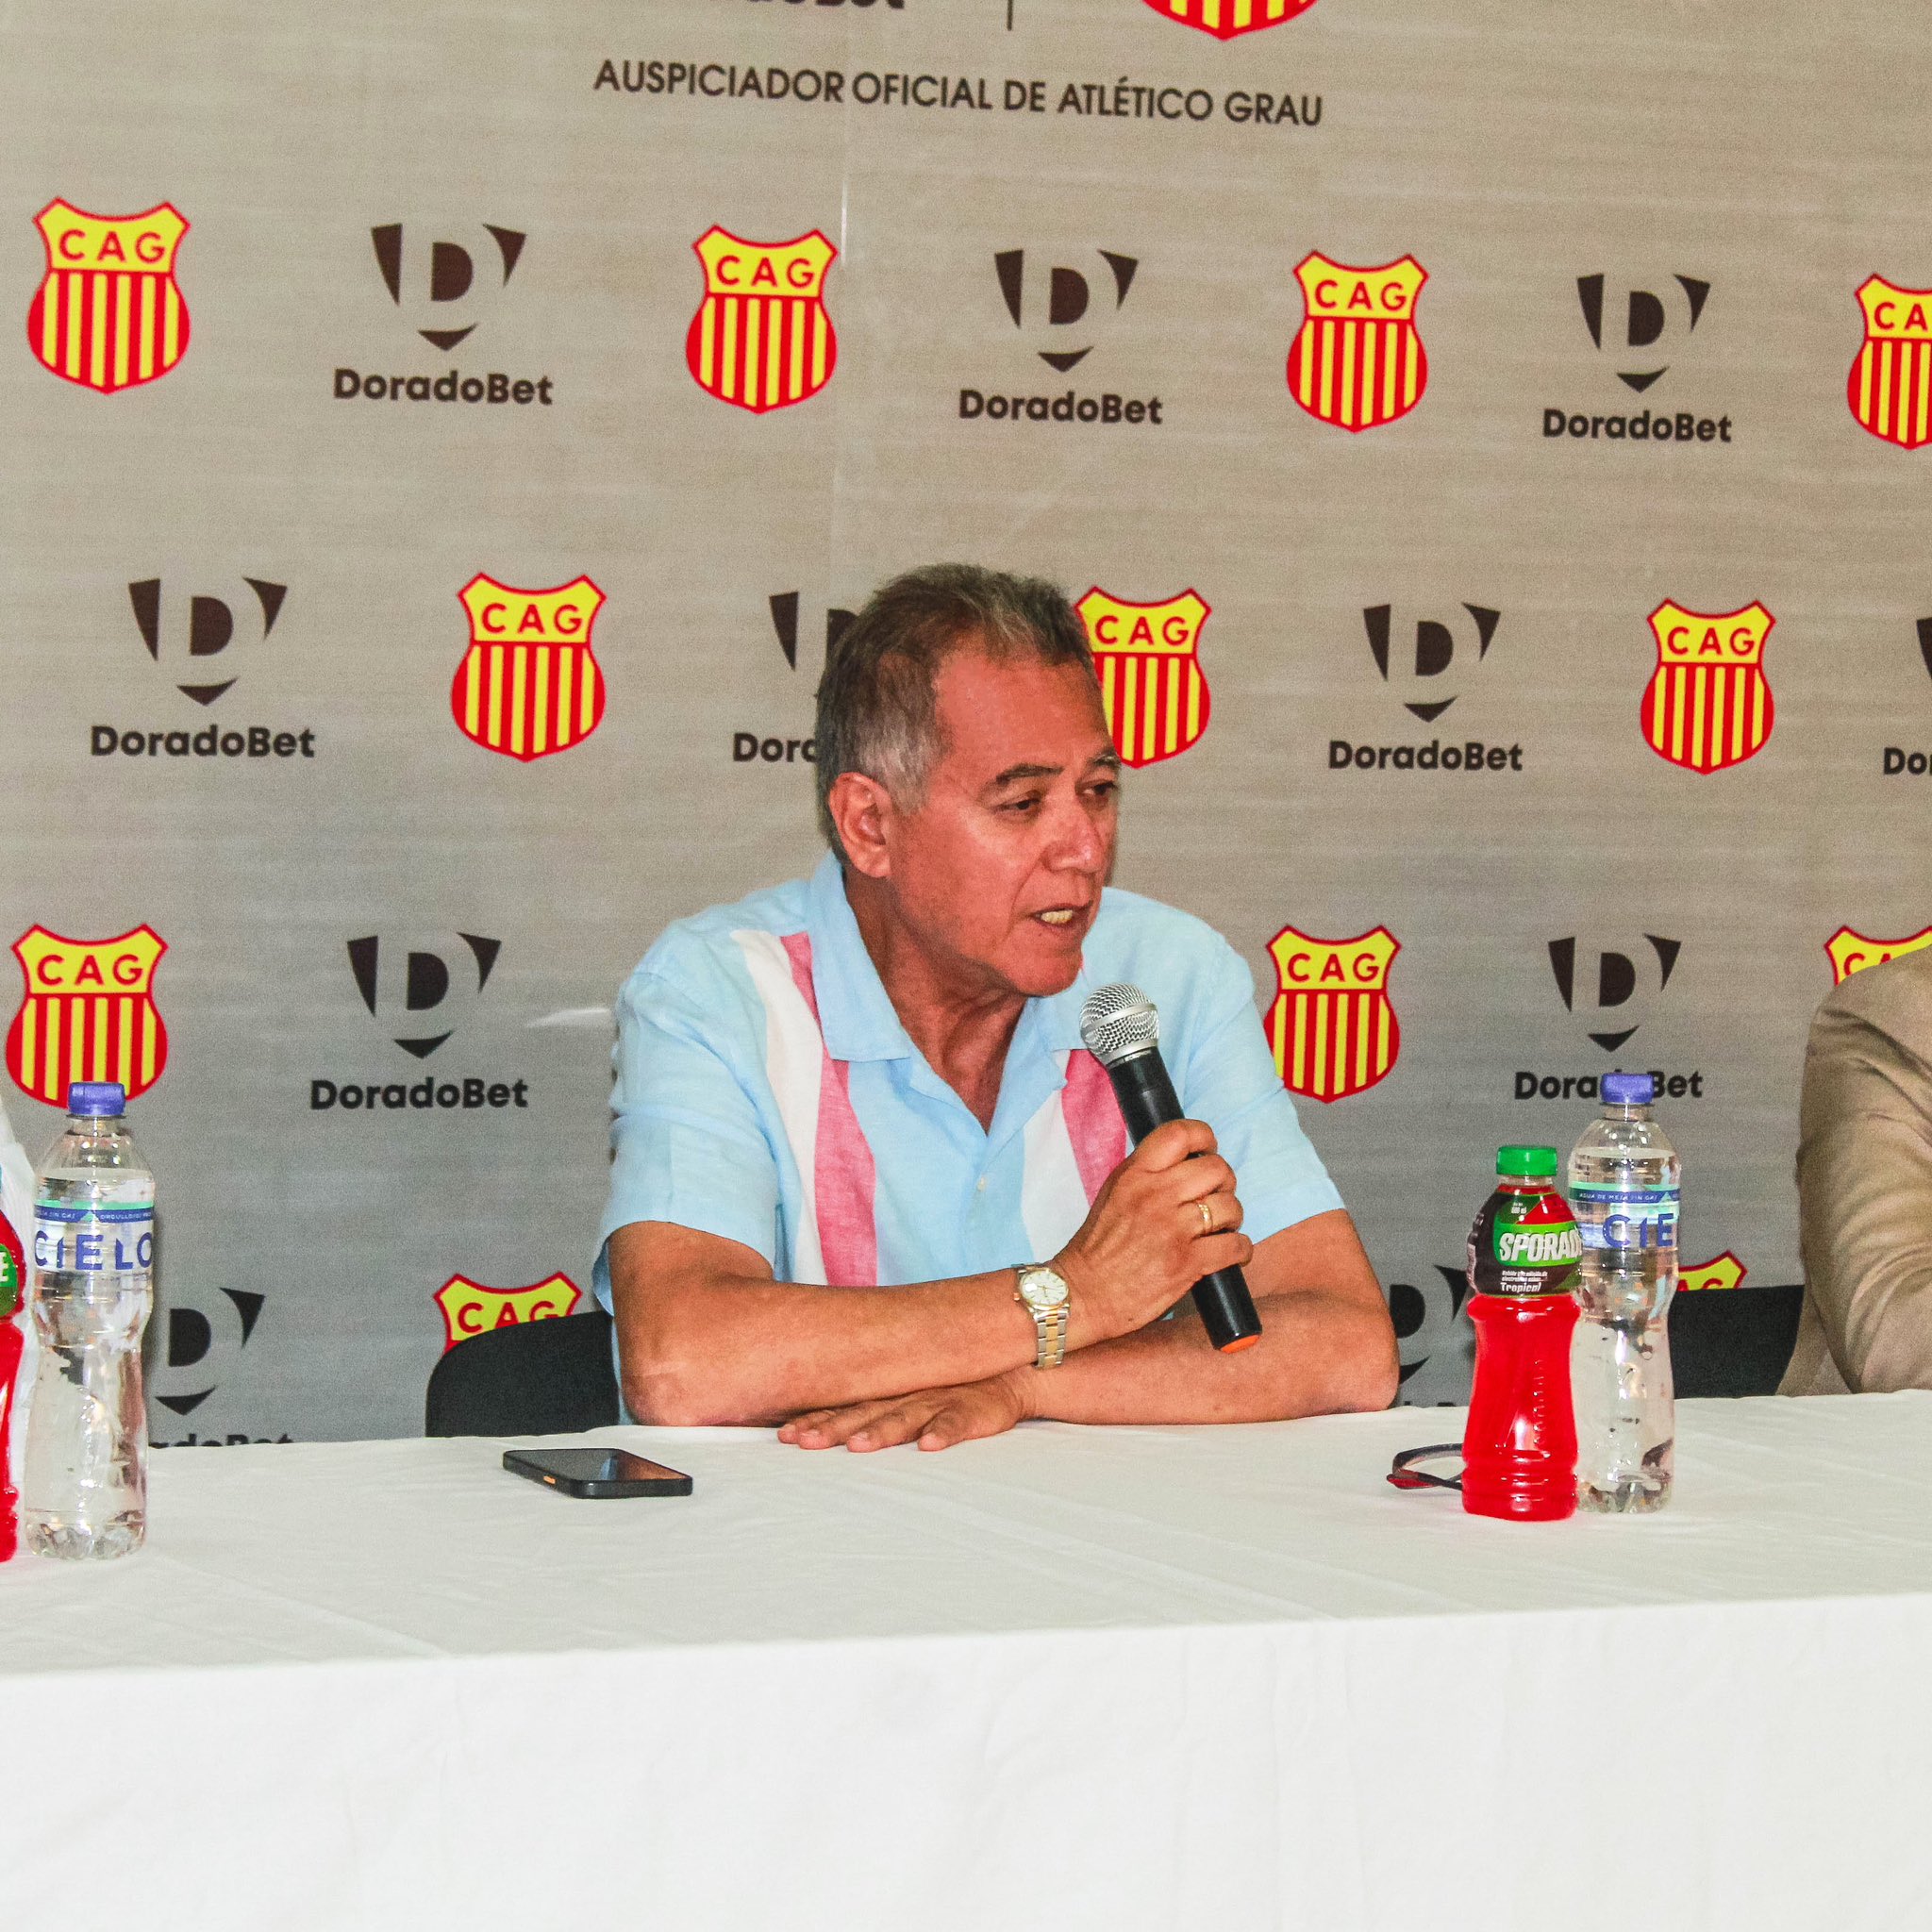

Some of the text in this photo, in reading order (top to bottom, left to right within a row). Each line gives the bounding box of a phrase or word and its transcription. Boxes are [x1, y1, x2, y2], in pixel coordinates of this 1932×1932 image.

[595, 59, 1323, 125] AUSPICIADOR OFICIAL DE ATLÉTICO GRAU
[59, 229, 165, 262] CAG
[716, 256, 815, 289] CAG
[1315, 280, 1407, 312] CAG
[335, 369, 552, 405] DoradoBet
[959, 390, 1161, 425] DoradoBet
[1543, 408, 1731, 442] DoradoBet
[482, 603, 582, 635] CAG
[1095, 615, 1189, 646] CAG
[1668, 626, 1755, 656] CAG
[92, 724, 314, 758] DoradoBet
[1329, 740, 1523, 771] DoradoBet
[1884, 747, 1932, 775] Do
[37, 954, 142, 986] CAG
[1288, 953, 1379, 983] CAG
[311, 1077, 527, 1109] DoradoBet
[1515, 1069, 1703, 1100] DoraBet
[35, 1230, 152, 1270] CIELO
[1500, 1281, 1542, 1293] Tropical
